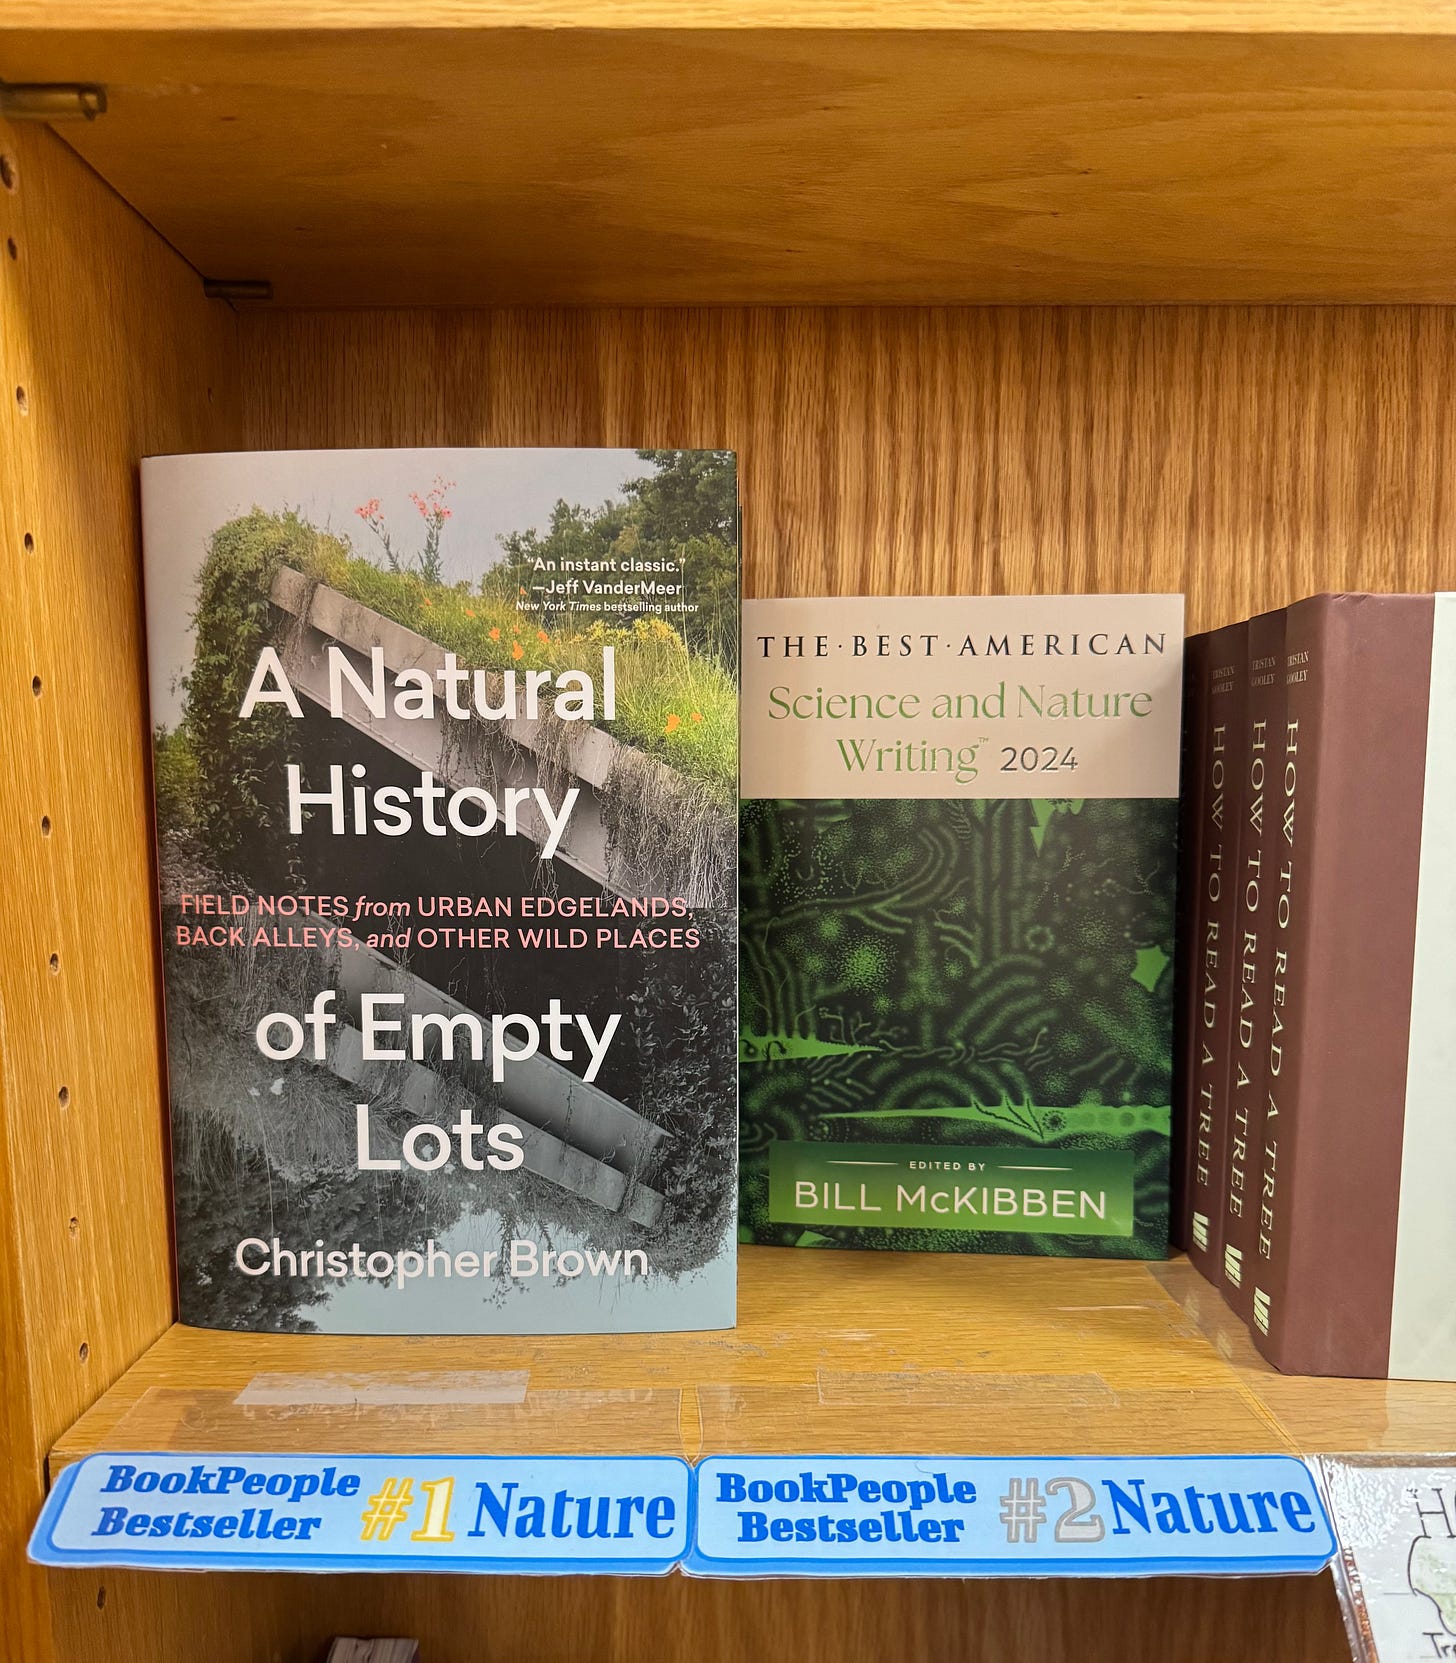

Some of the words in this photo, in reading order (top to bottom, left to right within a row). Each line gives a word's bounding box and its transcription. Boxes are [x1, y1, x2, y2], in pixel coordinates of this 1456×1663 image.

[528, 557, 556, 572] “An
[560, 557, 617, 572] instant
[583, 580, 682, 595] VanderMeer
[516, 601, 539, 611] New
[542, 601, 566, 611] York
[569, 601, 601, 611] Times
[604, 602, 661, 614] bestselling
[664, 603, 699, 612] author
[238, 646, 304, 718] A
[328, 646, 616, 721] Natural
[1252, 655, 1277, 671] TRISTAN
[768, 686, 920, 720] Science
[931, 681, 1007, 719] and
[1017, 684, 1153, 718] Nature
[1000, 746, 1079, 772] 2024
[1211, 725, 1225, 832] HOW
[1249, 719, 1266, 837] HOW
[1282, 719, 1299, 848] HOW
[287, 763, 581, 859] History
[1208, 844, 1223, 902] TO
[1245, 849, 1261, 912] TO
[1278, 861, 1293, 929] TO
[181, 895, 250, 916] FIELD
[258, 895, 349, 917] NOTES
[355, 895, 411, 919] from
[417, 897, 513, 917] URBAN
[520, 897, 694, 921] EDGELANDS,
[176, 926, 246, 947] BACK
[253, 926, 361, 951] ALLEYS,
[366, 927, 411, 948] and
[417, 928, 511, 948] OTHER
[519, 928, 590, 948] WILD
[597, 928, 701, 949] PLACES
[1203, 920, 1219, 1029] READ
[1239, 929, 1258, 1049] READ
[256, 990, 336, 1061] of
[361, 993, 622, 1083] Empty
[1269, 947, 1288, 1078] READ
[1201, 1043, 1216, 1066] A
[1236, 1061, 1251, 1089] A
[1266, 1093, 1281, 1120] A
[356, 1104, 525, 1171] Lots
[1196, 1083, 1213, 1187] TREE
[909, 1161, 961, 1170] EDITED
[968, 1163, 985, 1171] BY
[1229, 1107, 1249, 1219] TREE
[795, 1181, 882, 1211] BILL
[896, 1184, 1106, 1219] McKIBBEN
[1258, 1140, 1278, 1261] TREE
[235, 1238, 497, 1289] Christopher
[510, 1239, 649, 1277] Brown
[100, 1465, 361, 1502] BookPeople
[360, 1477, 456, 1542] #1
[467, 1482, 675, 1538] Nature
[716, 1472, 978, 1507] BookPeople
[999, 1477, 1106, 1544] #2
[1101, 1478, 1318, 1536] Nature
[91, 1507, 321, 1541] Bestseller
[737, 1511, 965, 1544] Bestseller
